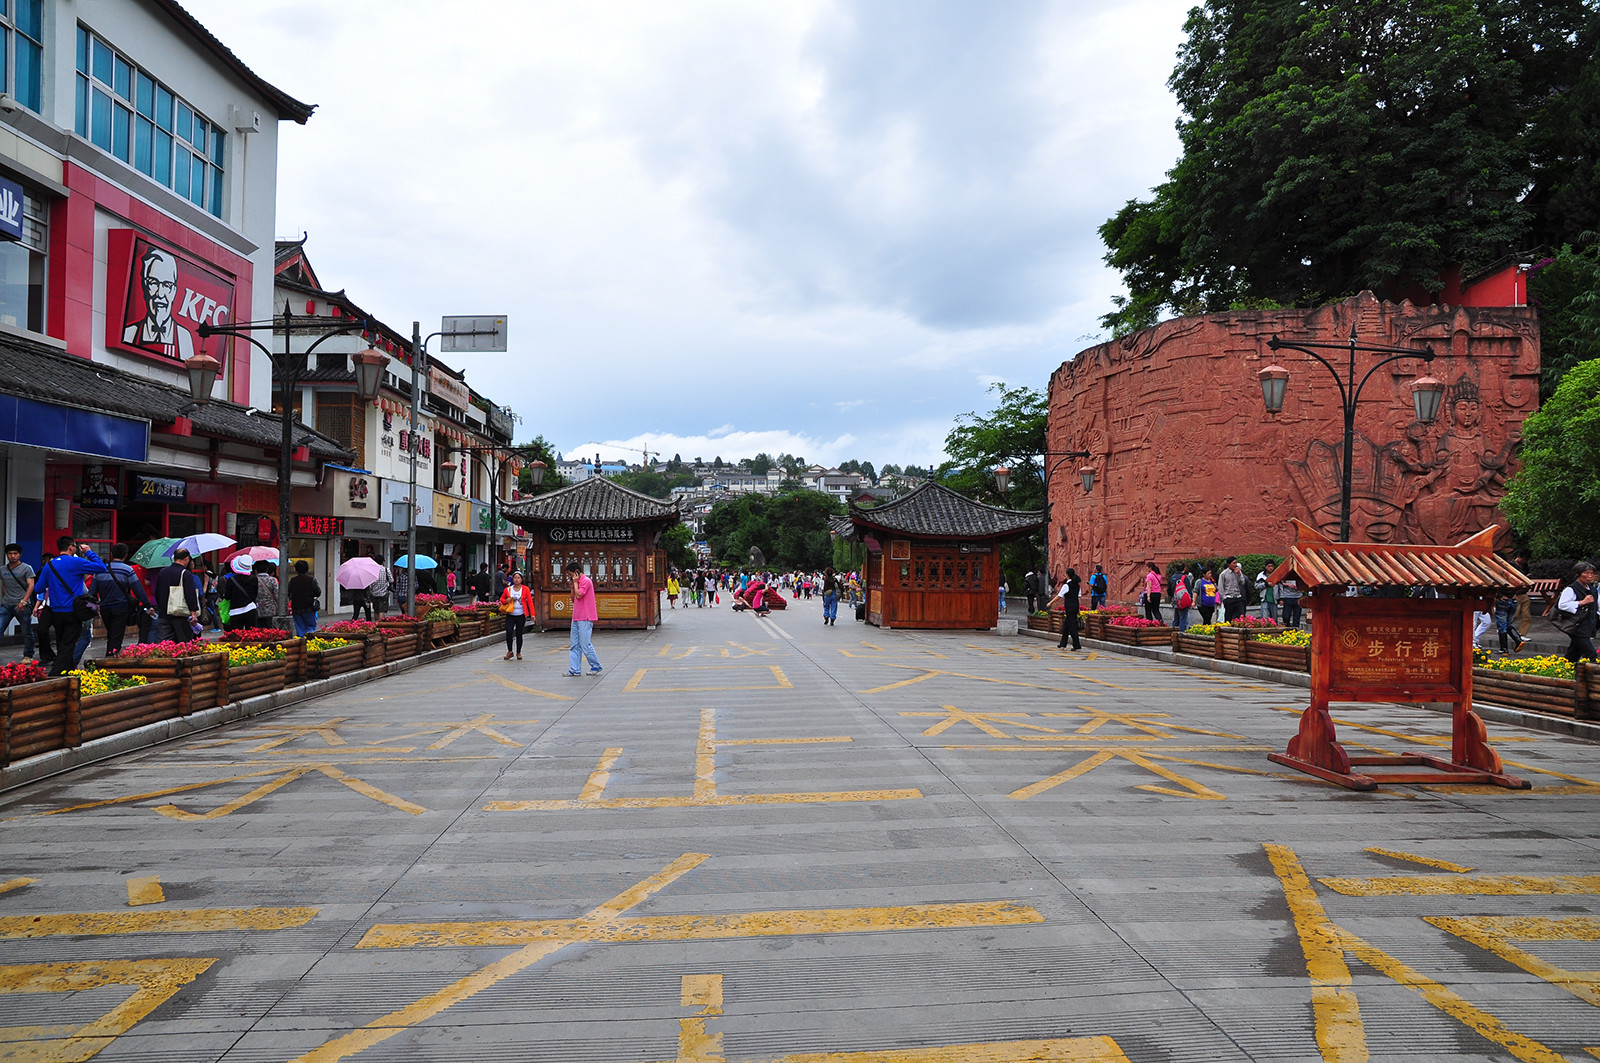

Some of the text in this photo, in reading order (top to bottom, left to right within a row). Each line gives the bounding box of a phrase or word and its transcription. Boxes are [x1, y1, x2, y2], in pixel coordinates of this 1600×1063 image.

[178, 288, 229, 326] KFC
[399, 429, 432, 459] 重火锅
[1367, 640, 1440, 658] 步行街
